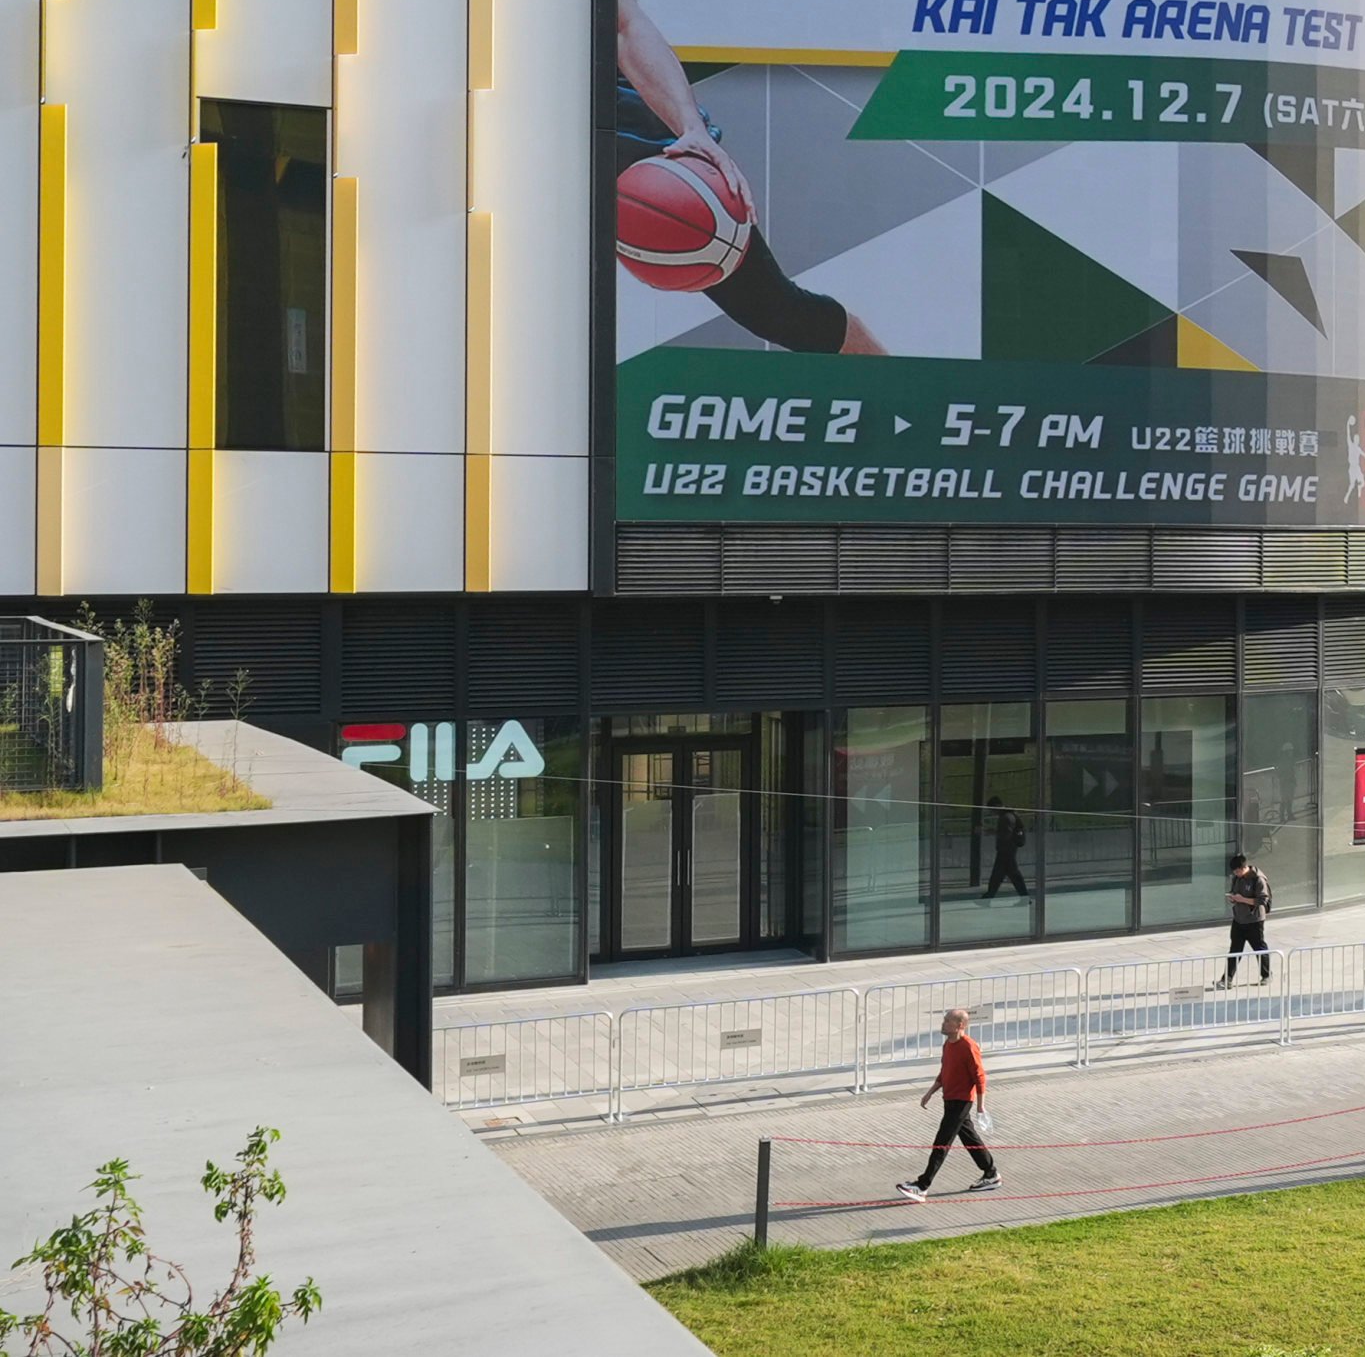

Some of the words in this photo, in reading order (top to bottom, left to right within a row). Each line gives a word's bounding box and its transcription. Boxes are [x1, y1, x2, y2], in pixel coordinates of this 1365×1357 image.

[1283, 7, 1363, 51] TEST
[943, 74, 1243, 123] 2024.12.7
[647, 394, 813, 442] GAME
[824, 399, 862, 443] 2
[940, 403, 1026, 447] 5-7
[1038, 414, 1104, 448] PM
[643, 463, 727, 495] U22
[742, 465, 1003, 499] BASKETBALL
[1019, 469, 1227, 502] CHALLENGE
[1237, 474, 1320, 503] GAME
[341, 719, 545, 782] FILA
